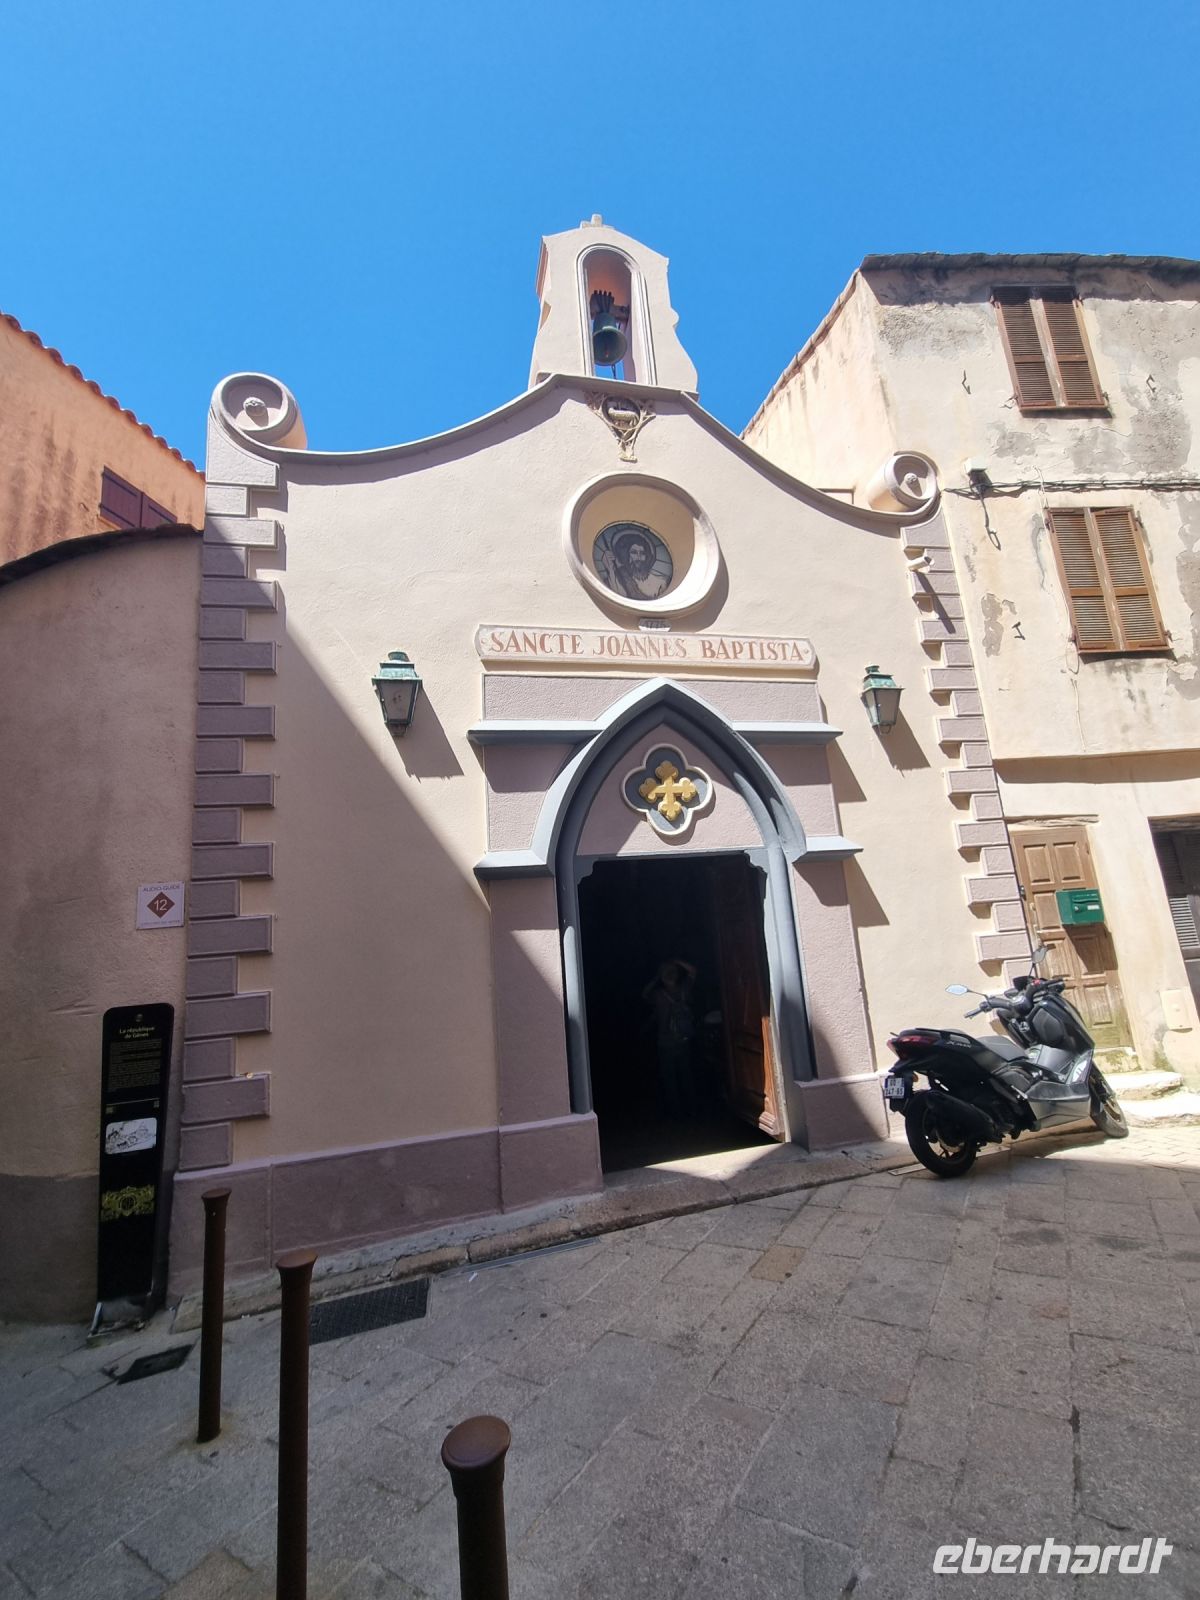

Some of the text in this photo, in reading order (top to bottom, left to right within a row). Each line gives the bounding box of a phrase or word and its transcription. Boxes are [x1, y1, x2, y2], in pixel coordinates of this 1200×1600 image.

[488, 630, 805, 662] SANCTE JOANNES BAPTISTA
[153, 899, 168, 912] 12
